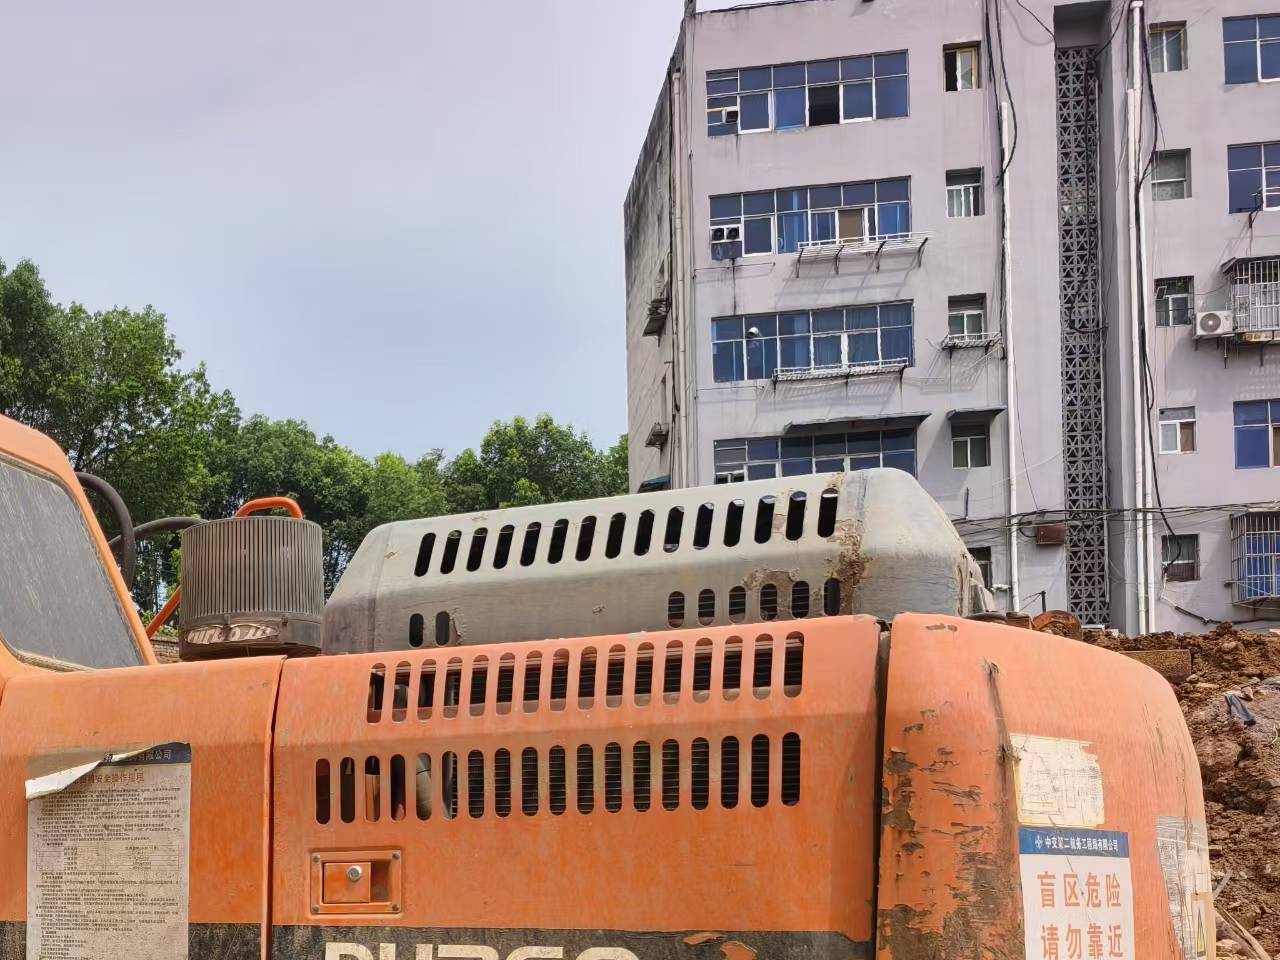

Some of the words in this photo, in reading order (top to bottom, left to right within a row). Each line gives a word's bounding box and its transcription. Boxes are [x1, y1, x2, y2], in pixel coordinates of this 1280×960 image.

[1037, 870, 1122, 909] 盲区危险
[1039, 923, 1124, 960] 请勿靠近
